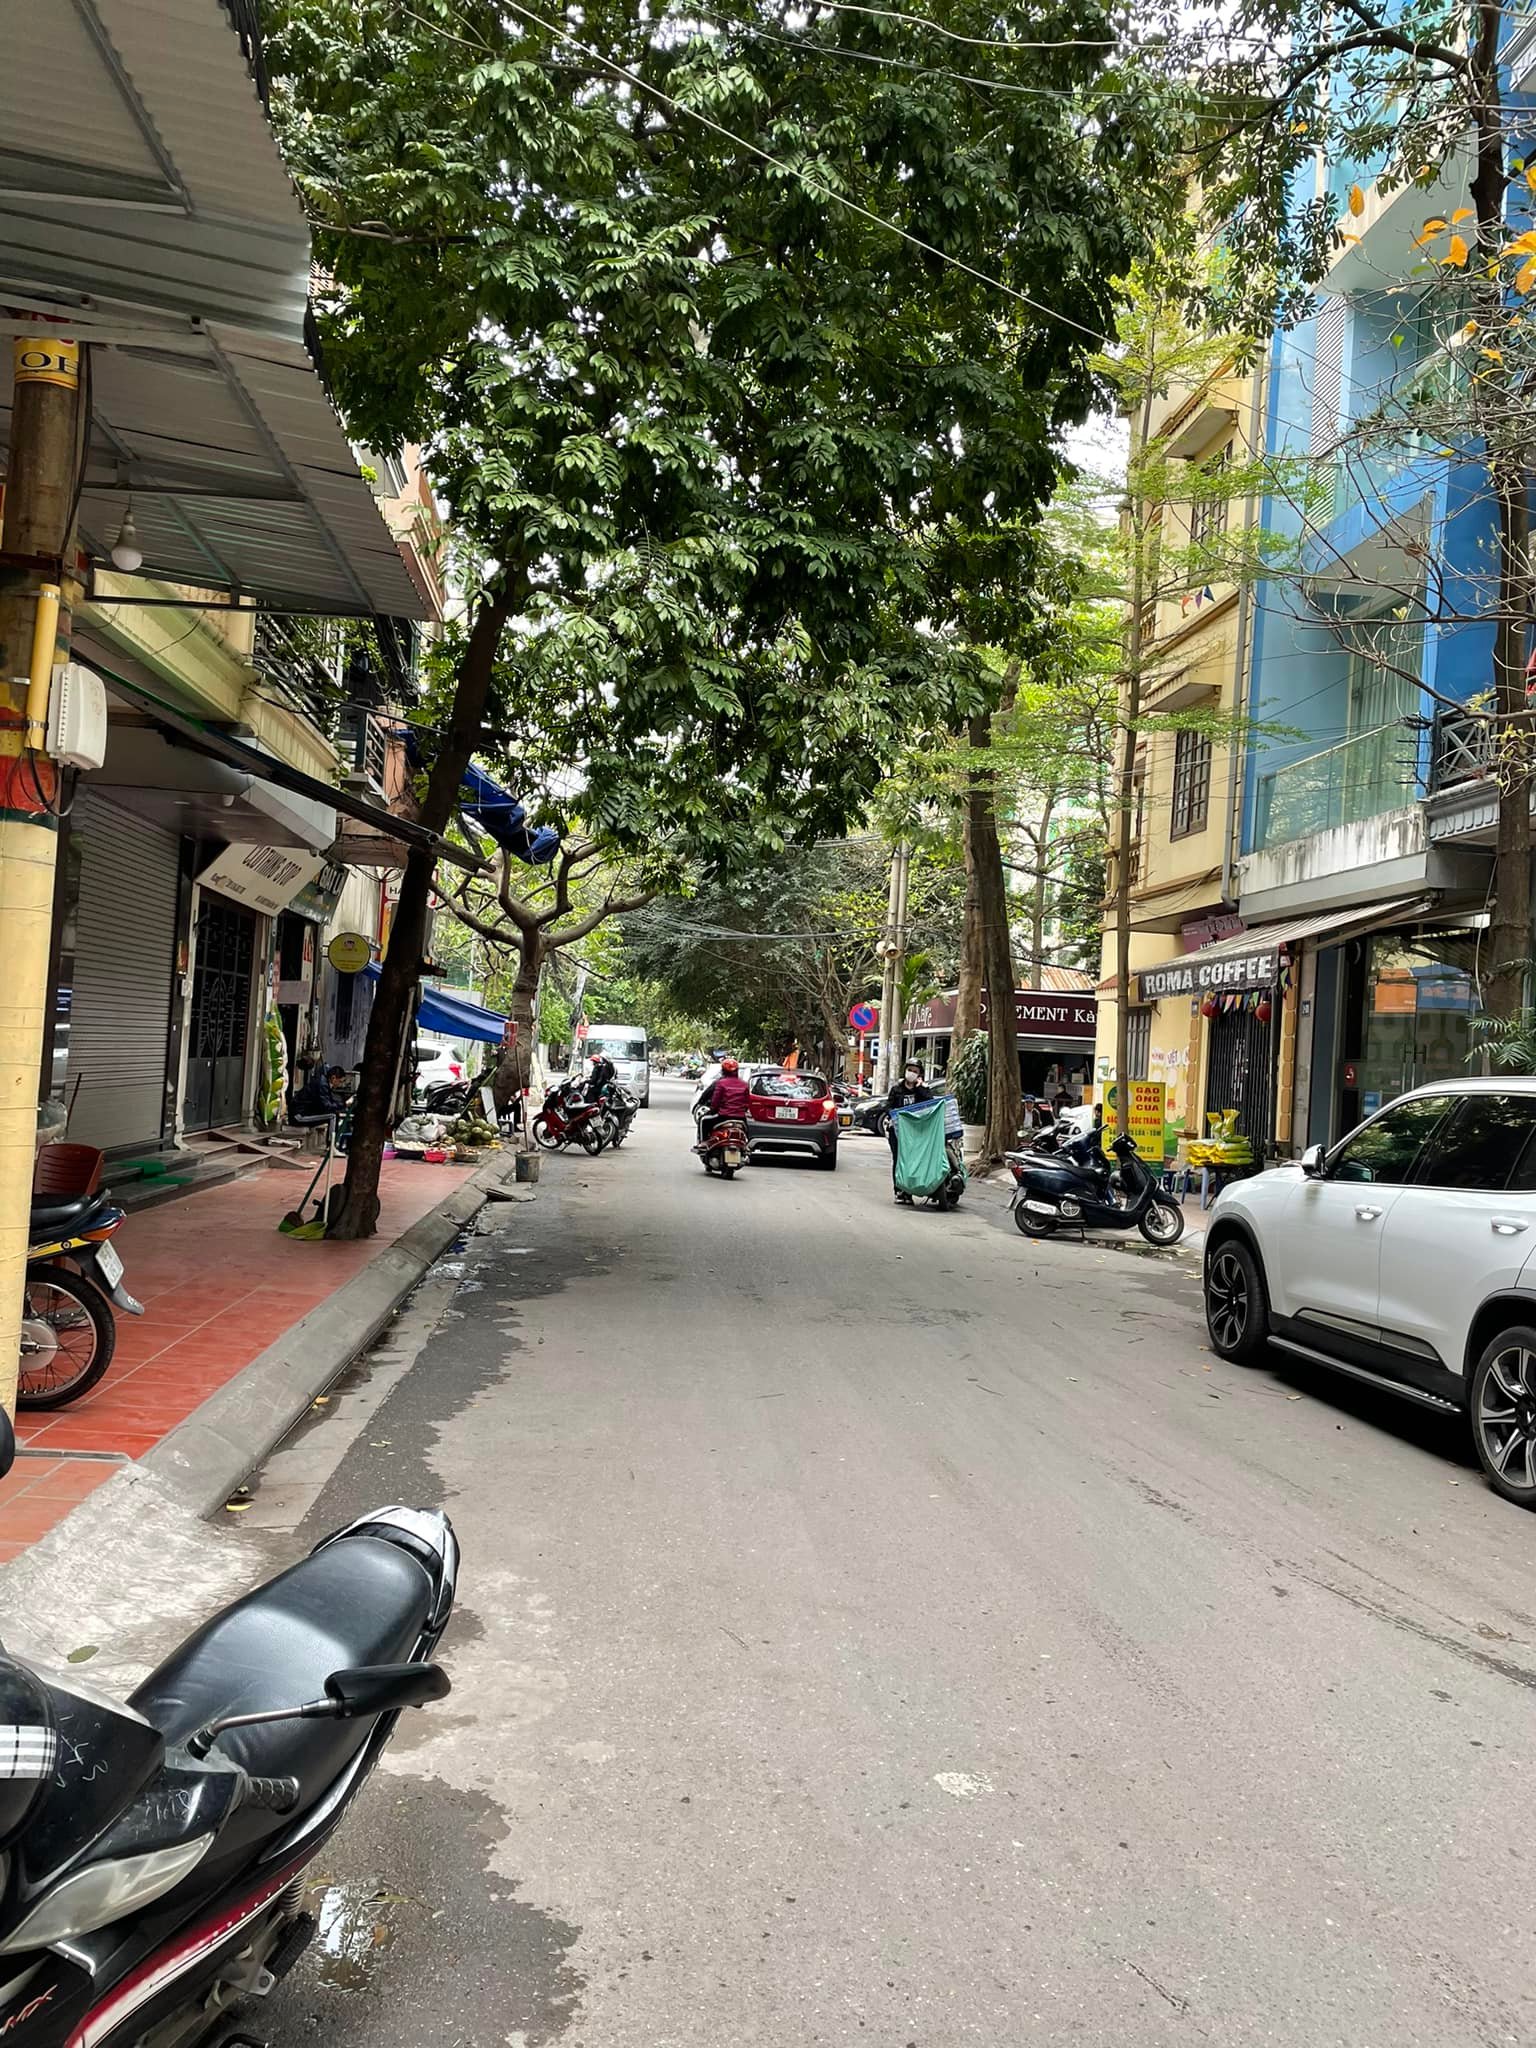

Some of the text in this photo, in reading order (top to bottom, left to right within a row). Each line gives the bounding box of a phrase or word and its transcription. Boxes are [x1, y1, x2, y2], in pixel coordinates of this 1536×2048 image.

[1145, 954, 1272, 994] ROMA COFFEE
[1074, 1008, 1097, 1023] Kà
